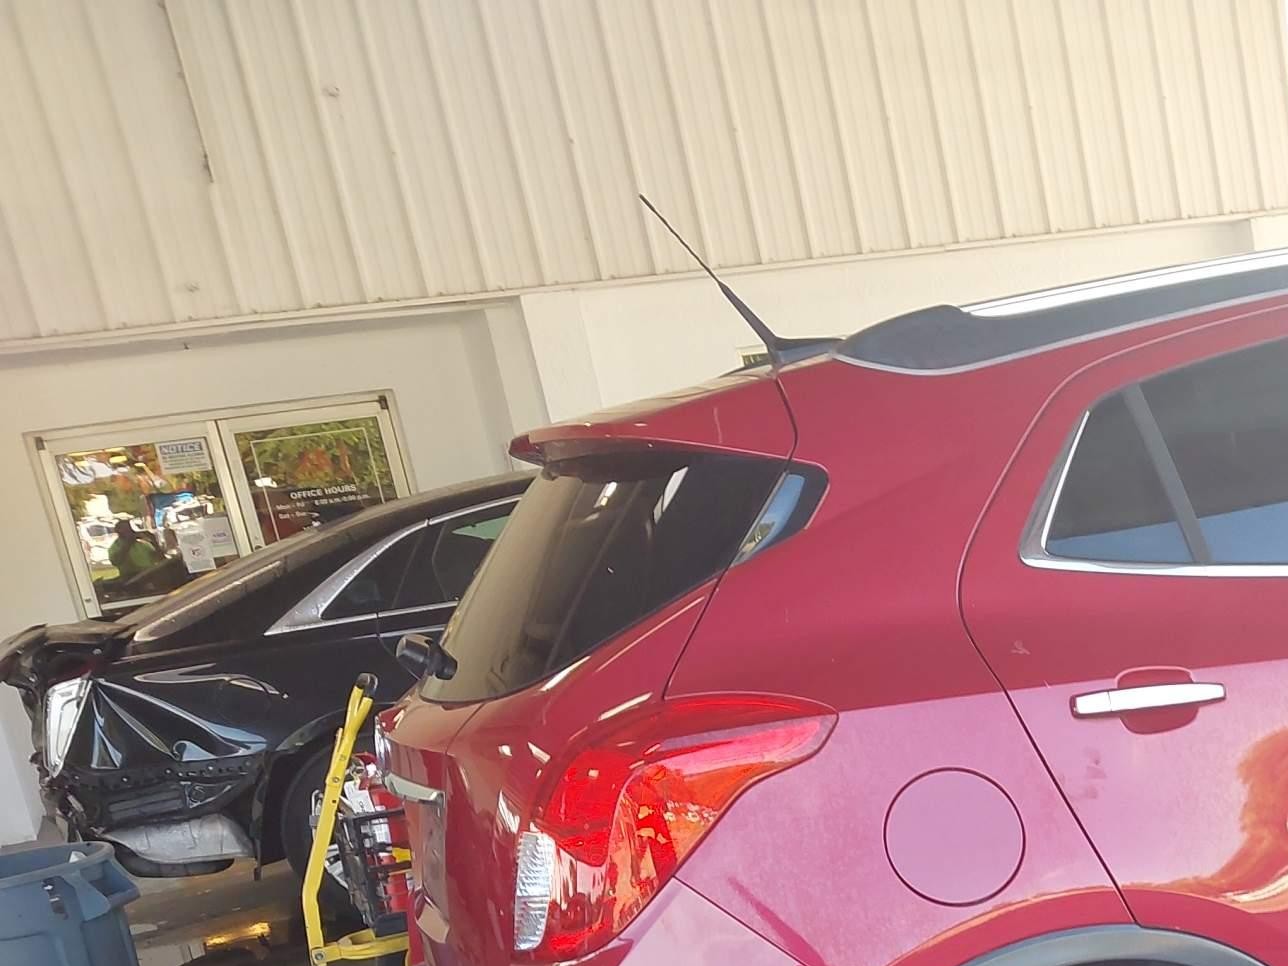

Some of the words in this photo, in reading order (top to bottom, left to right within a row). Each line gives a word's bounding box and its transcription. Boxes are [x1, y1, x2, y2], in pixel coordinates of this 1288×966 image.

[160, 442, 202, 454] NOTICE
[290, 488, 323, 499] OFFICE
[325, 484, 357, 494] HOURS
